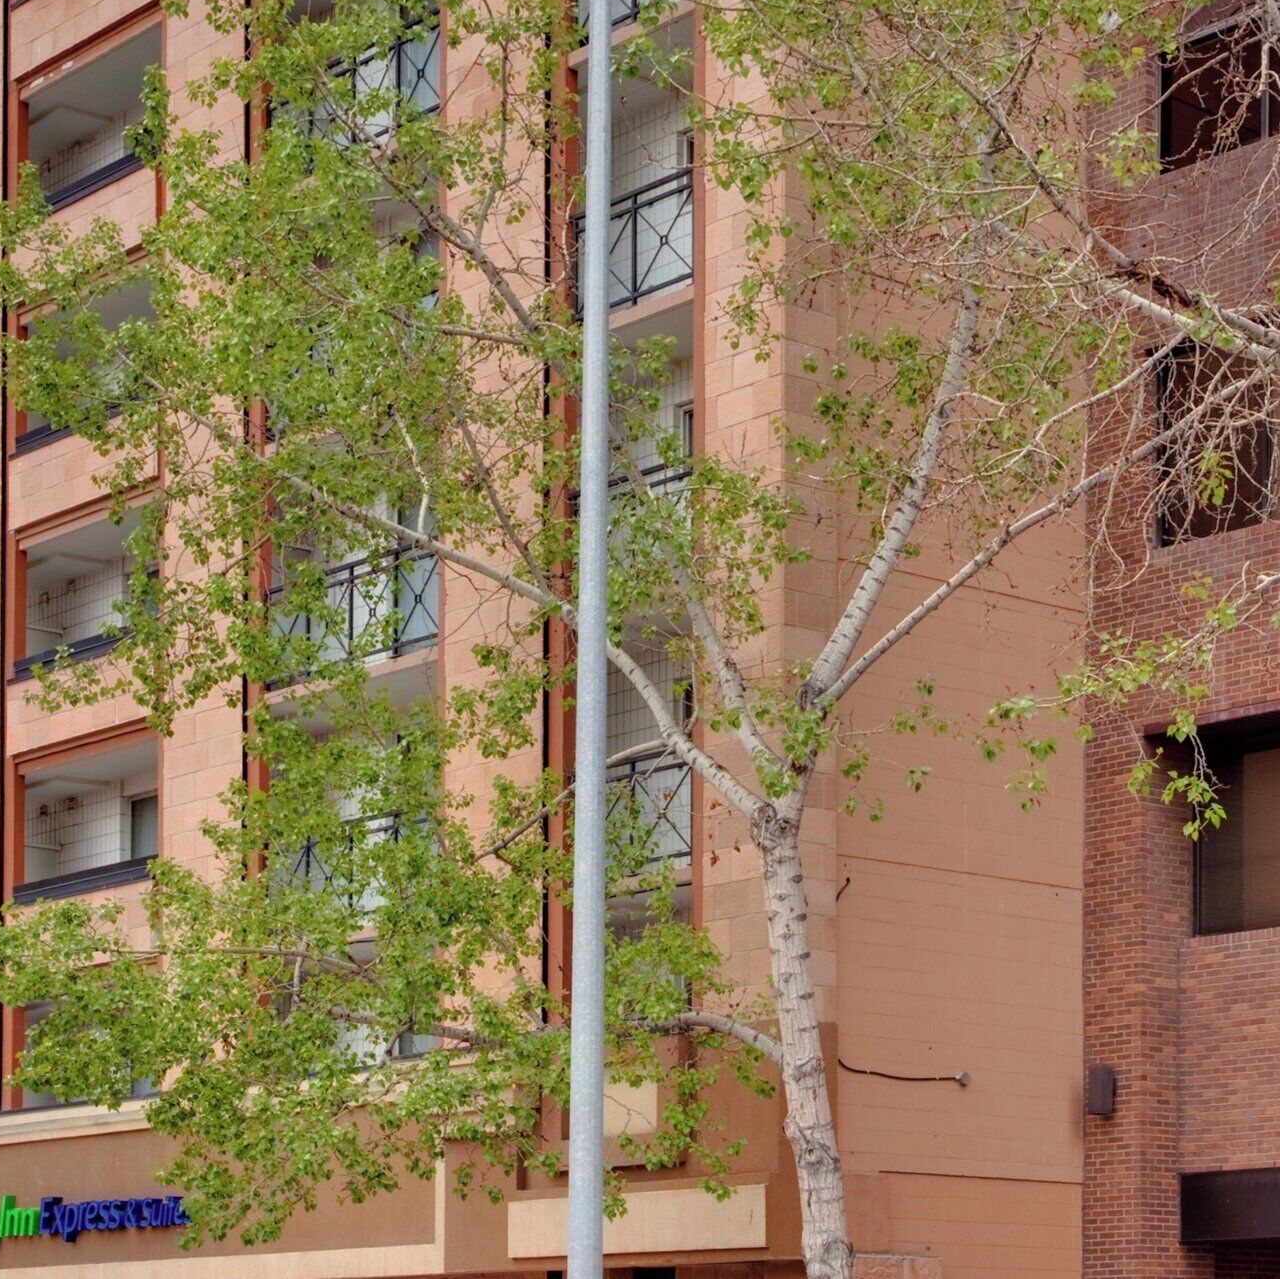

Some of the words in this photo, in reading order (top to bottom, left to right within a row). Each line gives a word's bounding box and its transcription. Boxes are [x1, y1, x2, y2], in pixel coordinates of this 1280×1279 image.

[39, 1196, 121, 1243] Express
[124, 1198, 140, 1228] &
[141, 1195, 192, 1228] Suite
